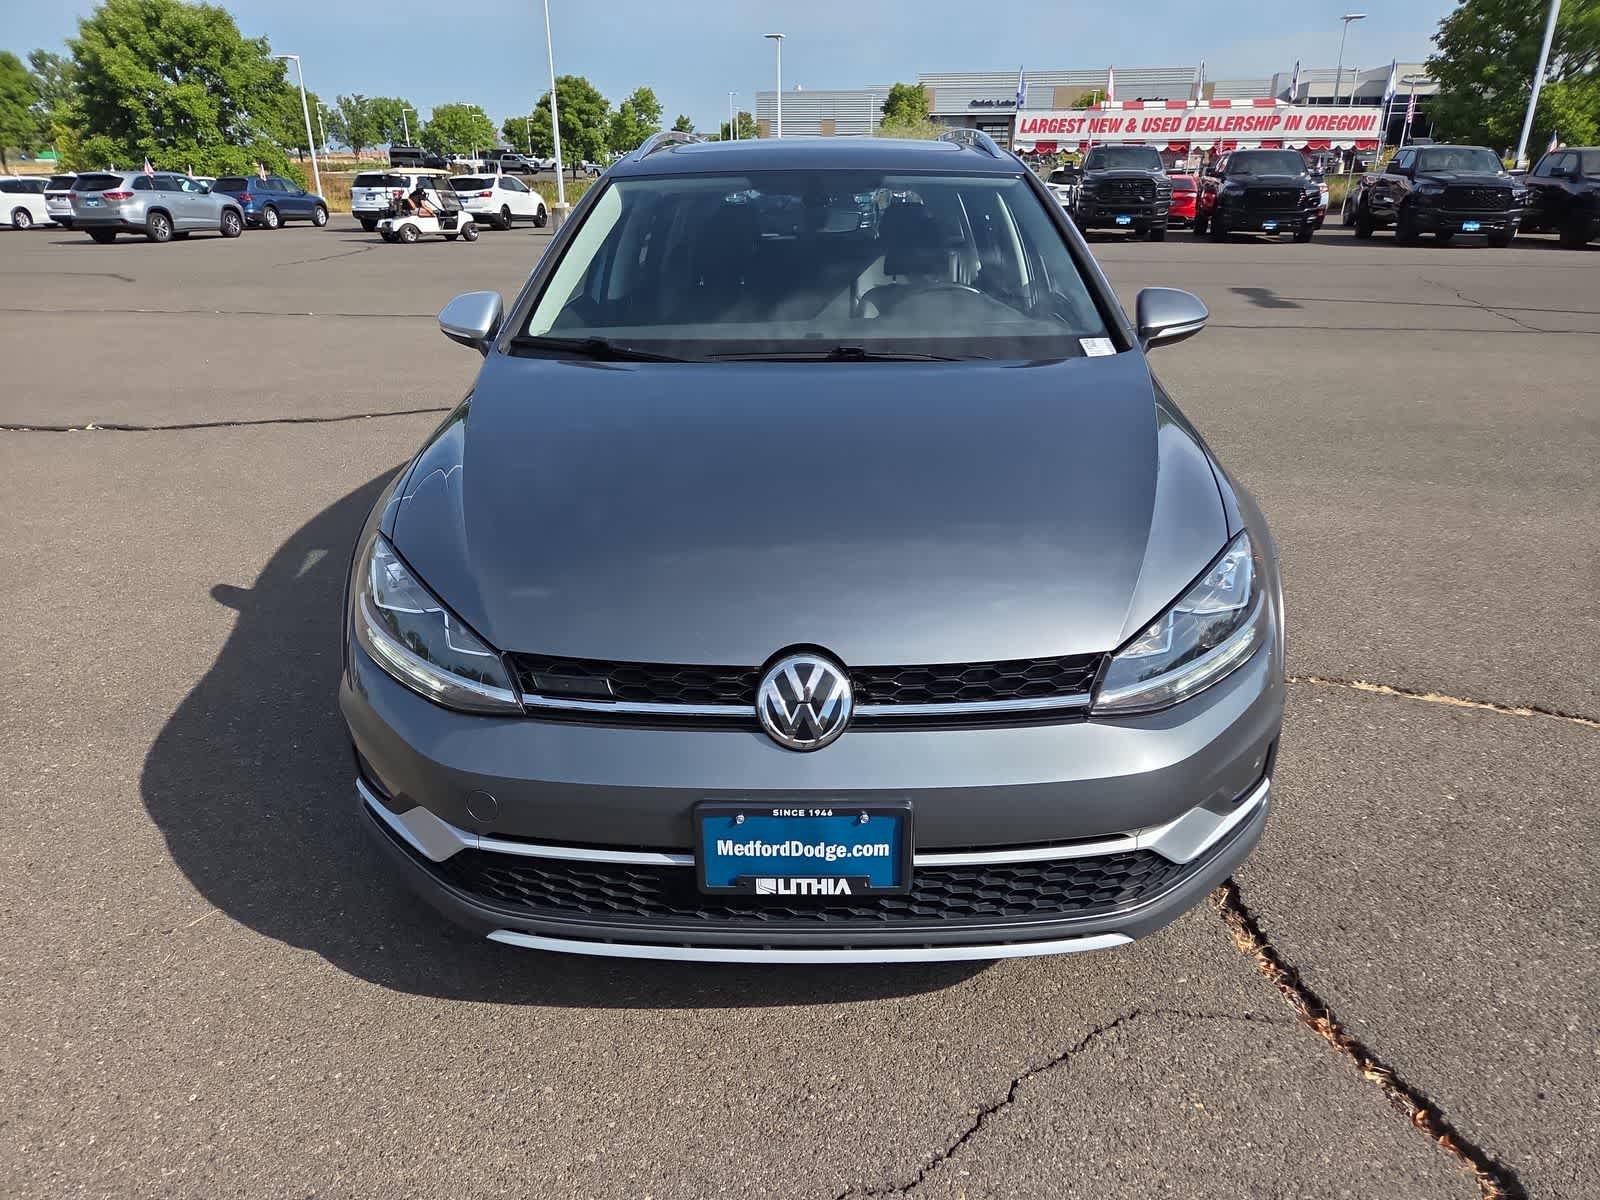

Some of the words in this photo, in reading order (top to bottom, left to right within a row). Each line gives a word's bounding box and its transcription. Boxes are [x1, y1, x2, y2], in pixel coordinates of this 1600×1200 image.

[1020, 118, 1085, 134] LARGEST
[1088, 118, 1124, 133] NEW
[1125, 117, 1137, 133] &
[1141, 117, 1183, 133] USED
[1185, 115, 1281, 132] DEALERSHIP
[1283, 115, 1303, 131] IN
[1305, 115, 1377, 131] OREGON!
[772, 809, 805, 817] SINCE
[808, 809, 833, 817] 1946
[717, 839, 890, 862] MedfordDodge.com
[777, 878, 852, 895] LITHIA
